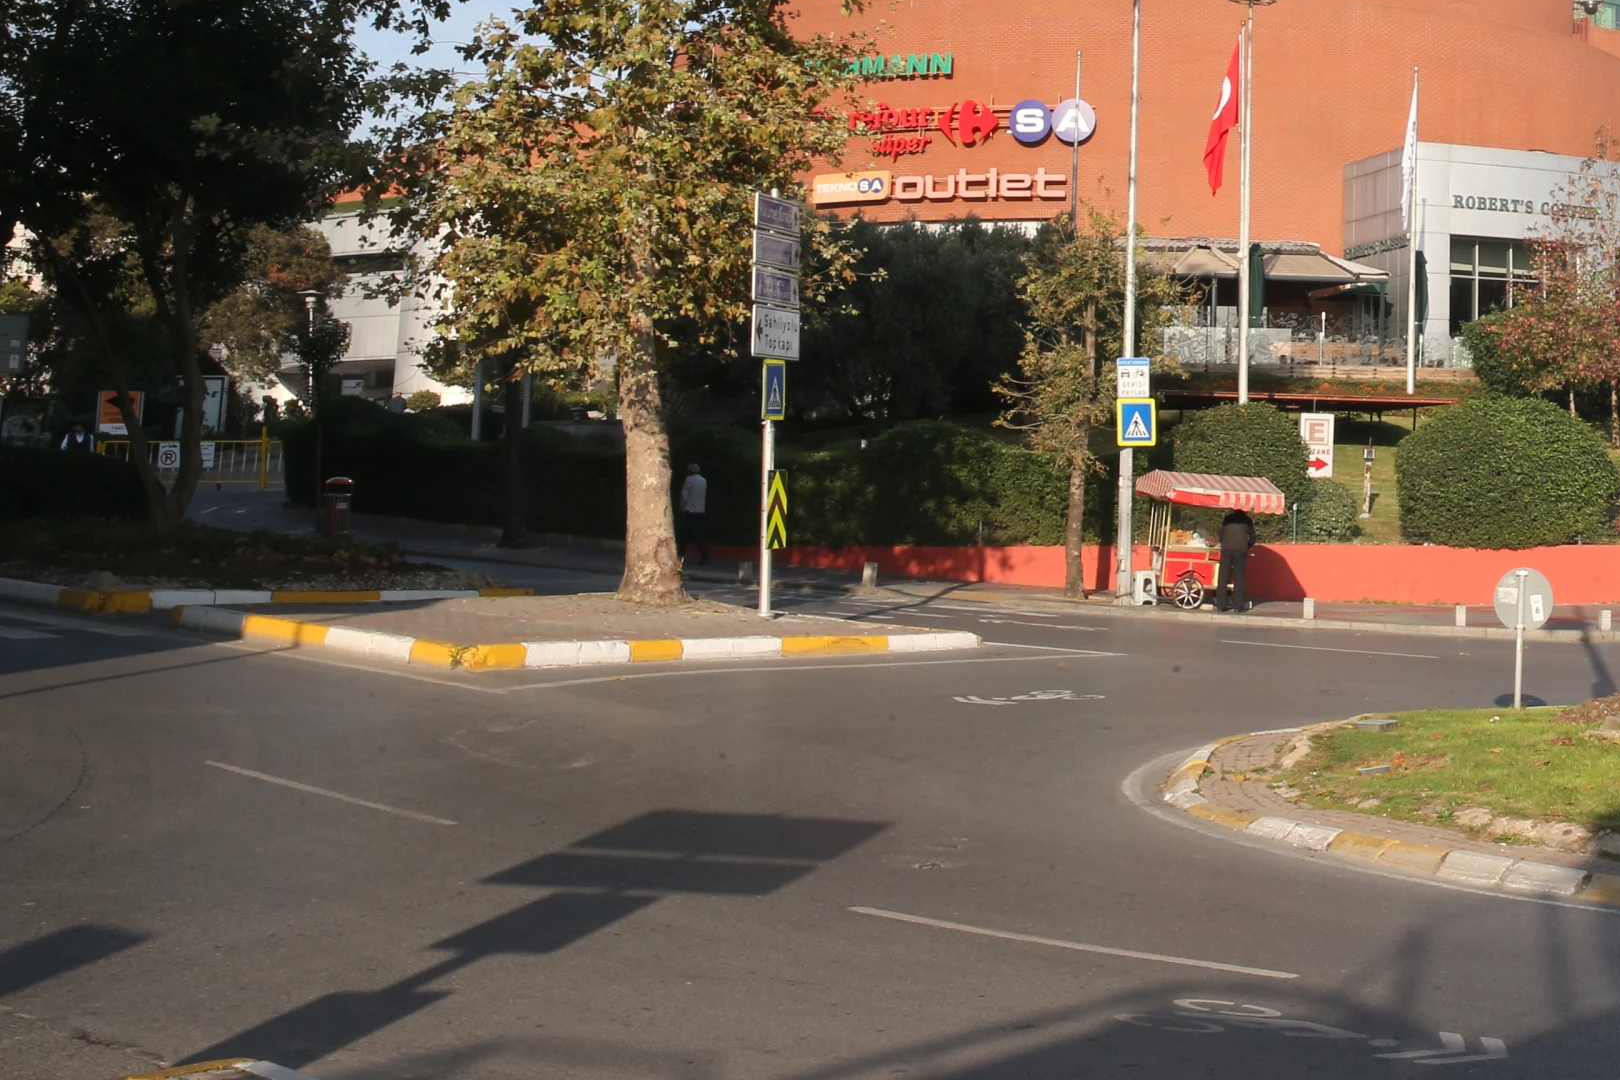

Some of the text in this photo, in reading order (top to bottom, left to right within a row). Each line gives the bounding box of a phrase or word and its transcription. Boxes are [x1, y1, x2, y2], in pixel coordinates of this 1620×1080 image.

[896, 167, 1067, 199] outlet
[1452, 194, 1534, 214] ROBERT'S
[764, 314, 798, 334] Sahilyolu
[764, 334, 793, 355] Topkapı
[1309, 422, 1325, 442] E
